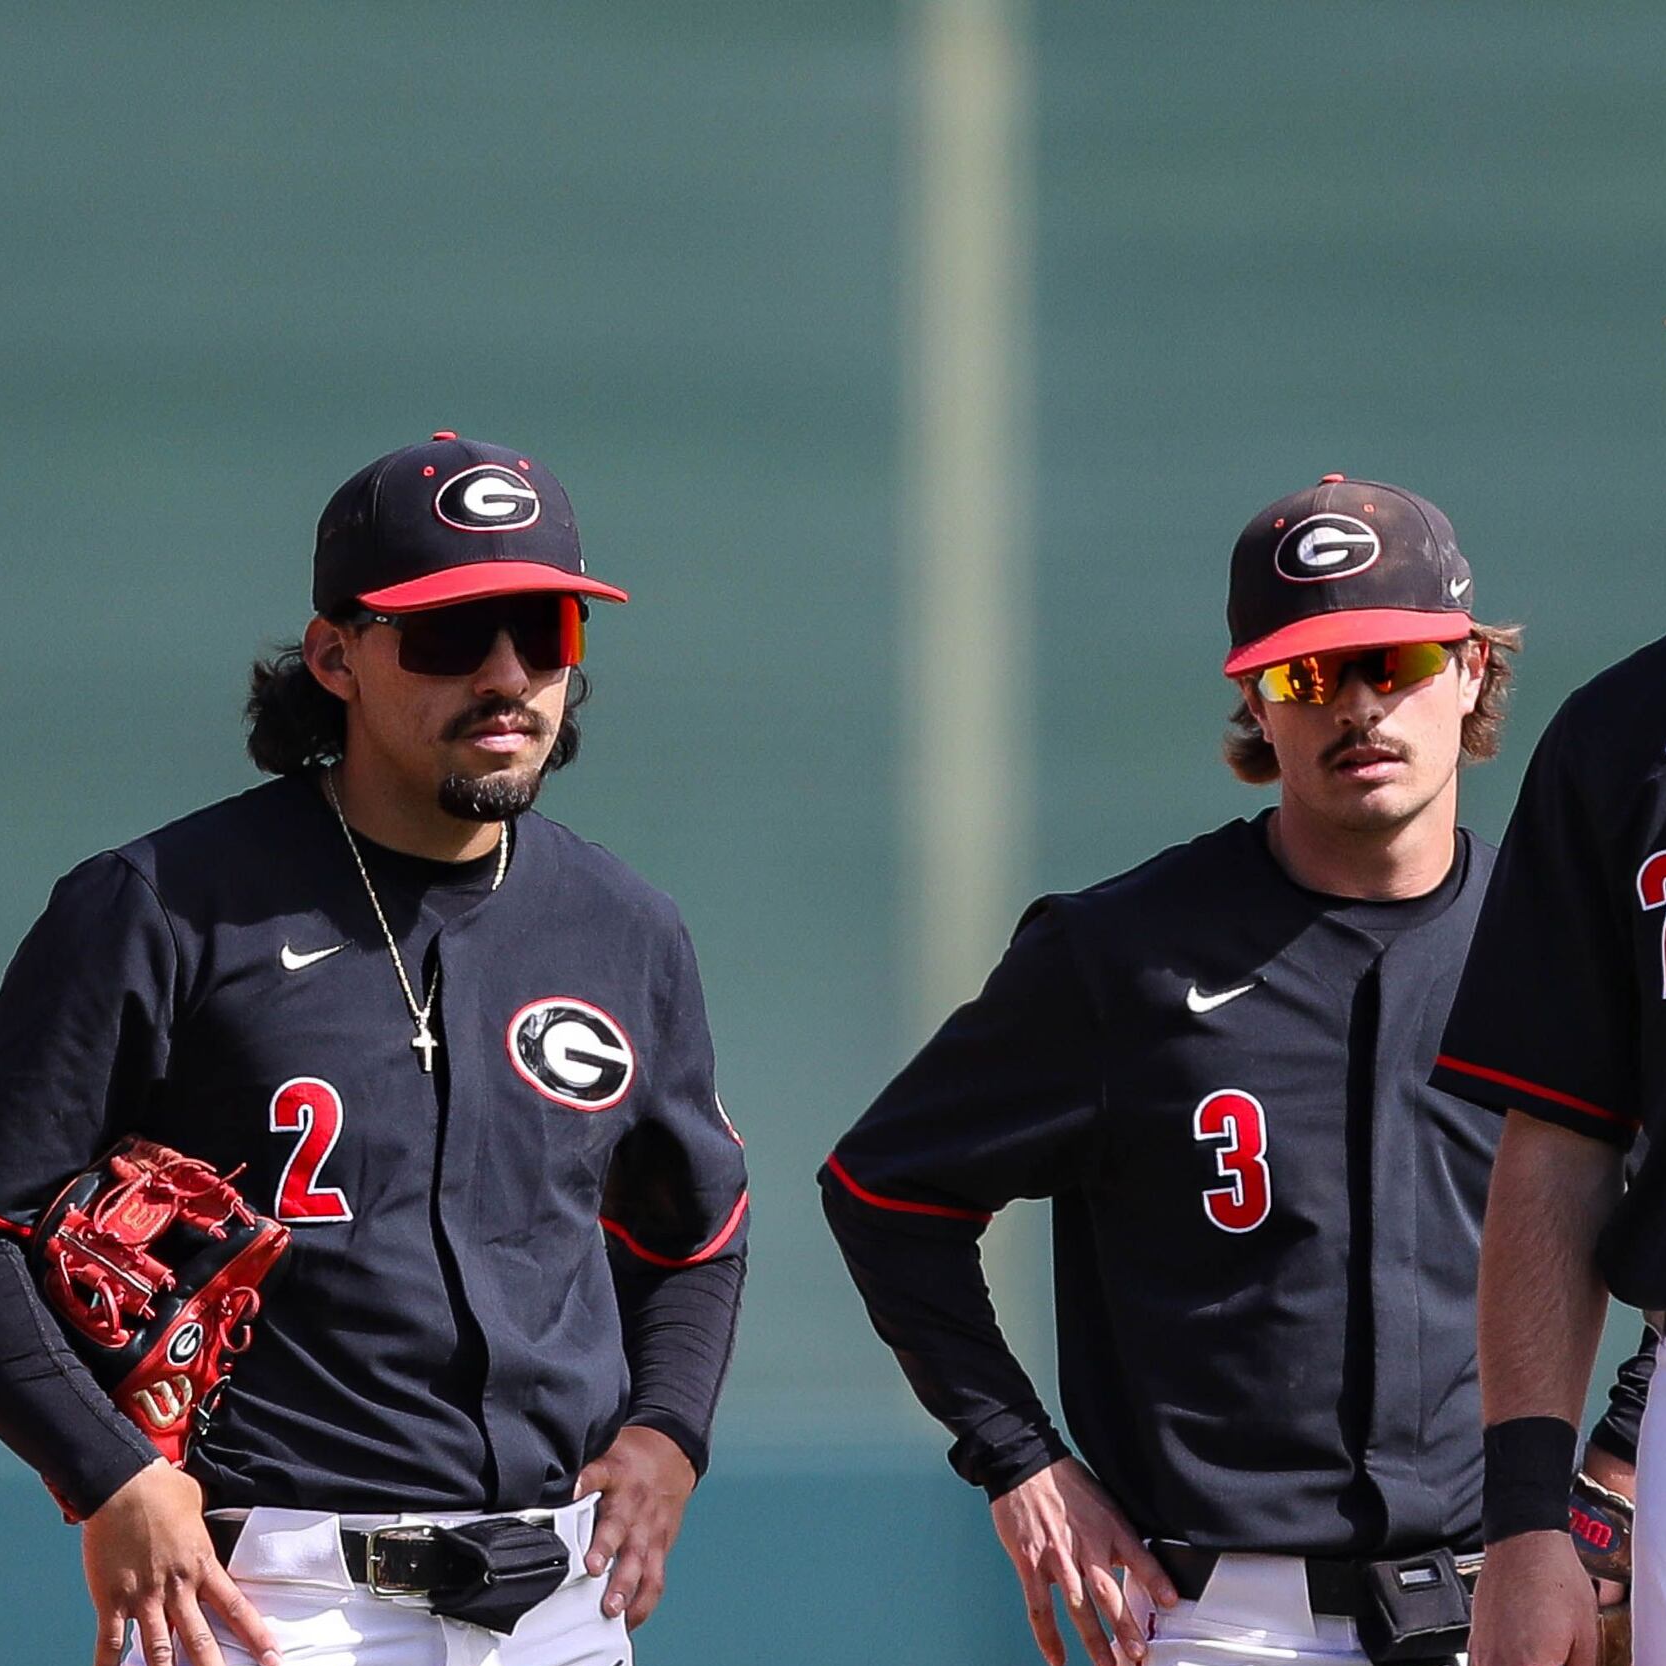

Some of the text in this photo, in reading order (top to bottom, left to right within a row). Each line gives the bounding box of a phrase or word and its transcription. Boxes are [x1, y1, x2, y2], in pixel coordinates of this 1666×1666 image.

[269, 1076, 354, 1223] 2
[1193, 1088, 1271, 1234] 3
[132, 1374, 194, 1428] W
